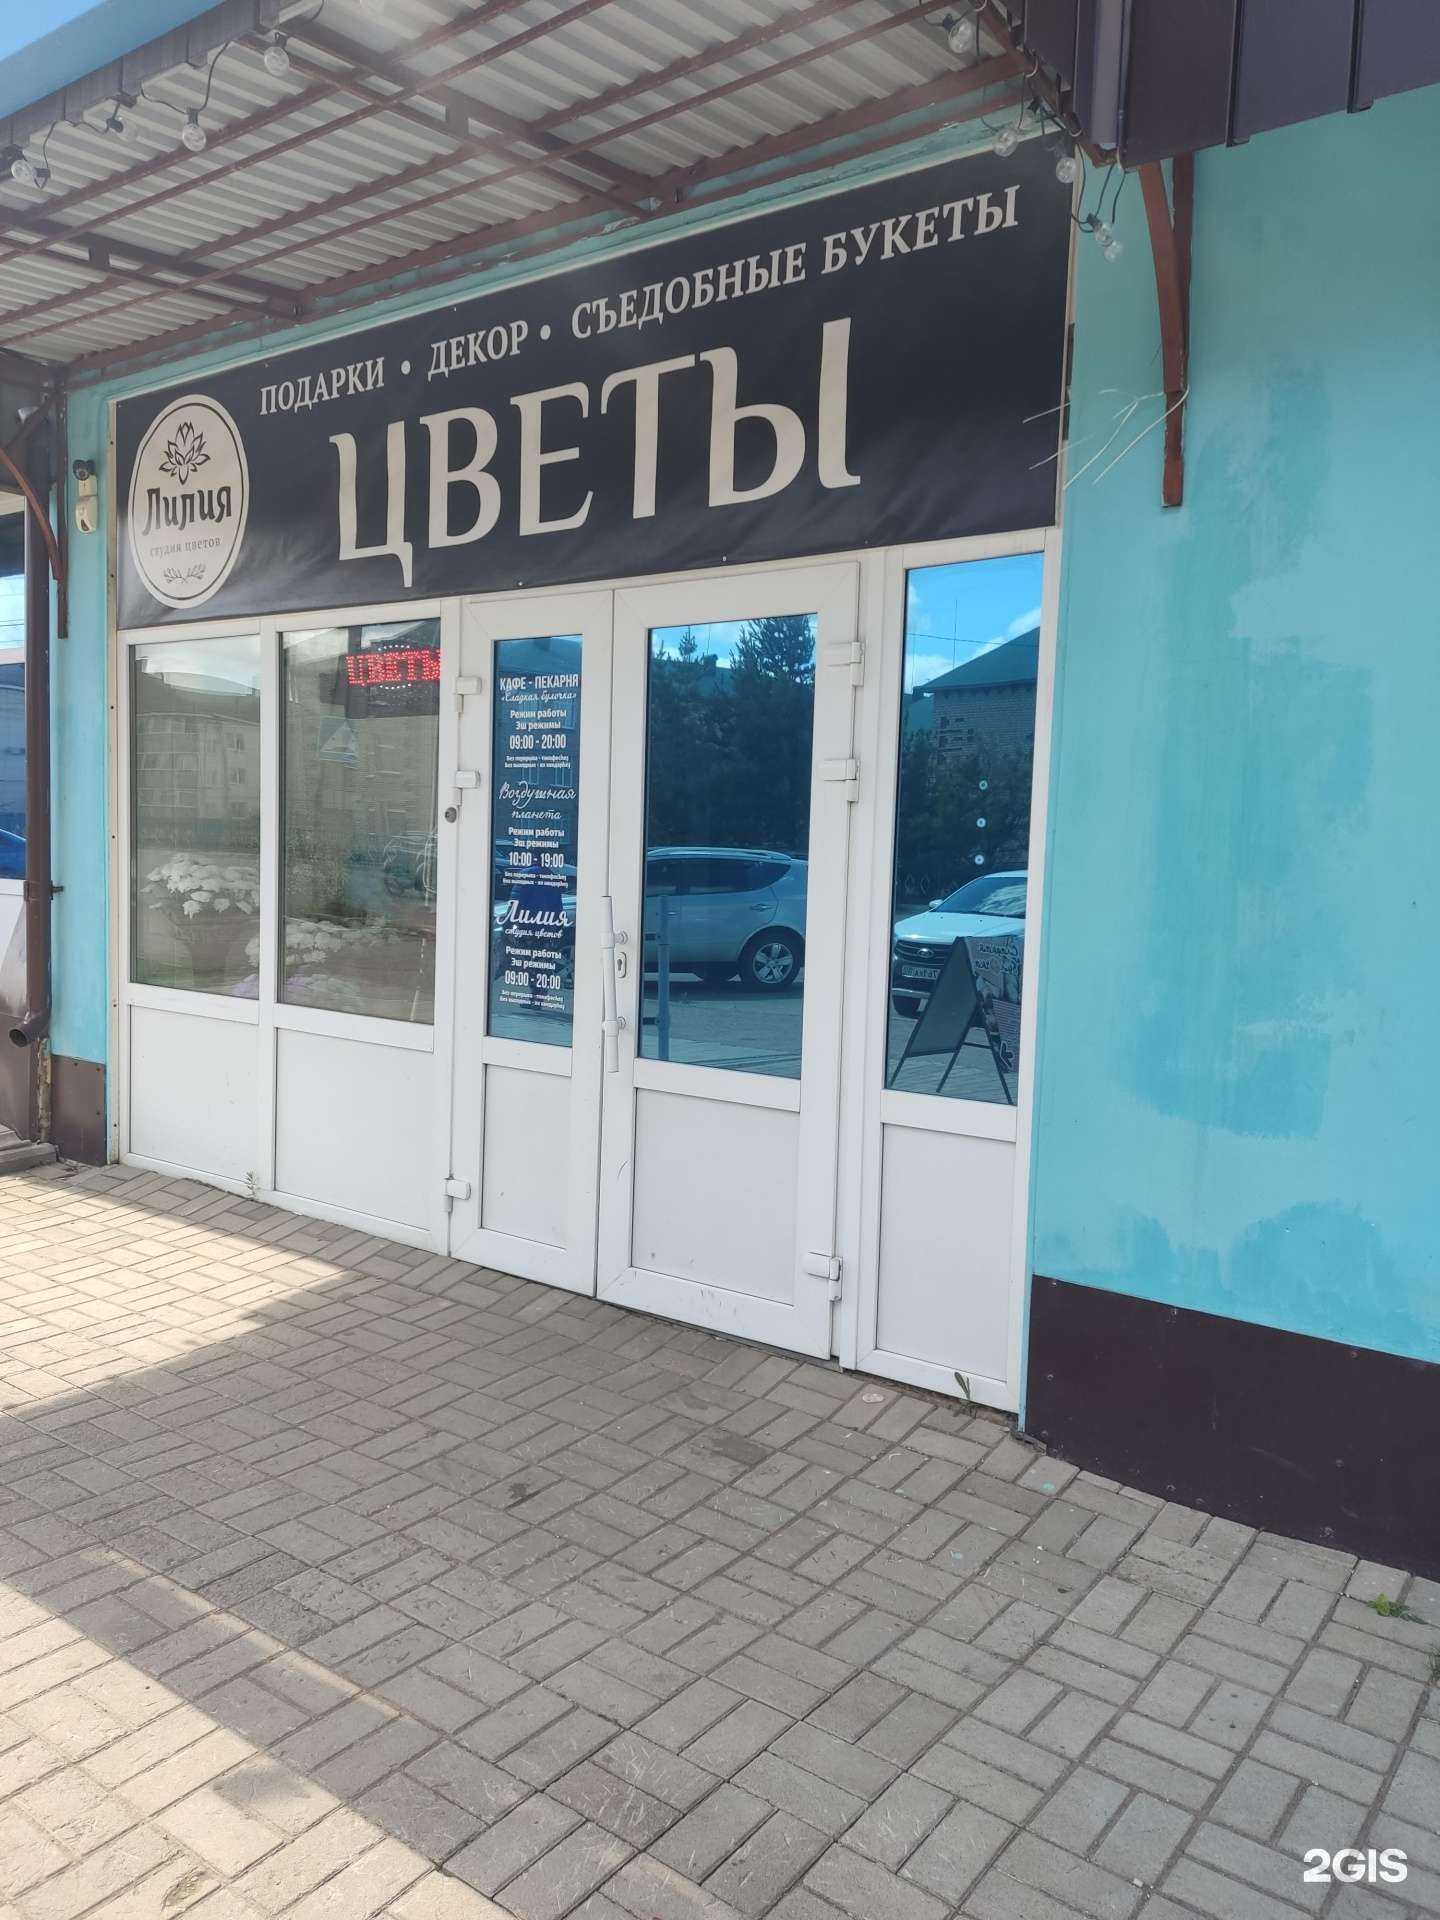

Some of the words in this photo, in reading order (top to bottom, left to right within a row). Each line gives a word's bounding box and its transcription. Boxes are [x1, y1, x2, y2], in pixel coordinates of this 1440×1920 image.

[259, 357, 385, 416] ПОДАРКИ
[427, 320, 529, 381] ДЕКОР
[571, 243, 807, 340] СЪЕДОБНЫЕ
[821, 184, 1021, 274] БУКЕТЫ
[329, 316, 862, 588] ЦВЕТЫ
[141, 485, 232, 537] Лилия
[150, 542, 183, 559] студия
[184, 536, 222, 553] цветов
[500, 677, 527, 691] КАФЕ
[535, 673, 579, 689] ПЕКАРНЯ
[510, 710, 536, 719] Режим
[537, 708, 567, 720] работы
[509, 735, 534, 750] 09:00
[541, 734, 567, 749] 20:00
[499, 780, 576, 809] Воздушная
[508, 827, 534, 837] Режим
[535, 828, 565, 839] работы
[508, 852, 532, 867] 10:00
[540, 853, 564, 868] 19:00
[496, 899, 573, 927] Лилия
[505, 946, 531, 957] Режим
[532, 947, 562, 960] работы
[504, 971, 529, 986] 09:00
[536, 974, 561, 990] 20:00
